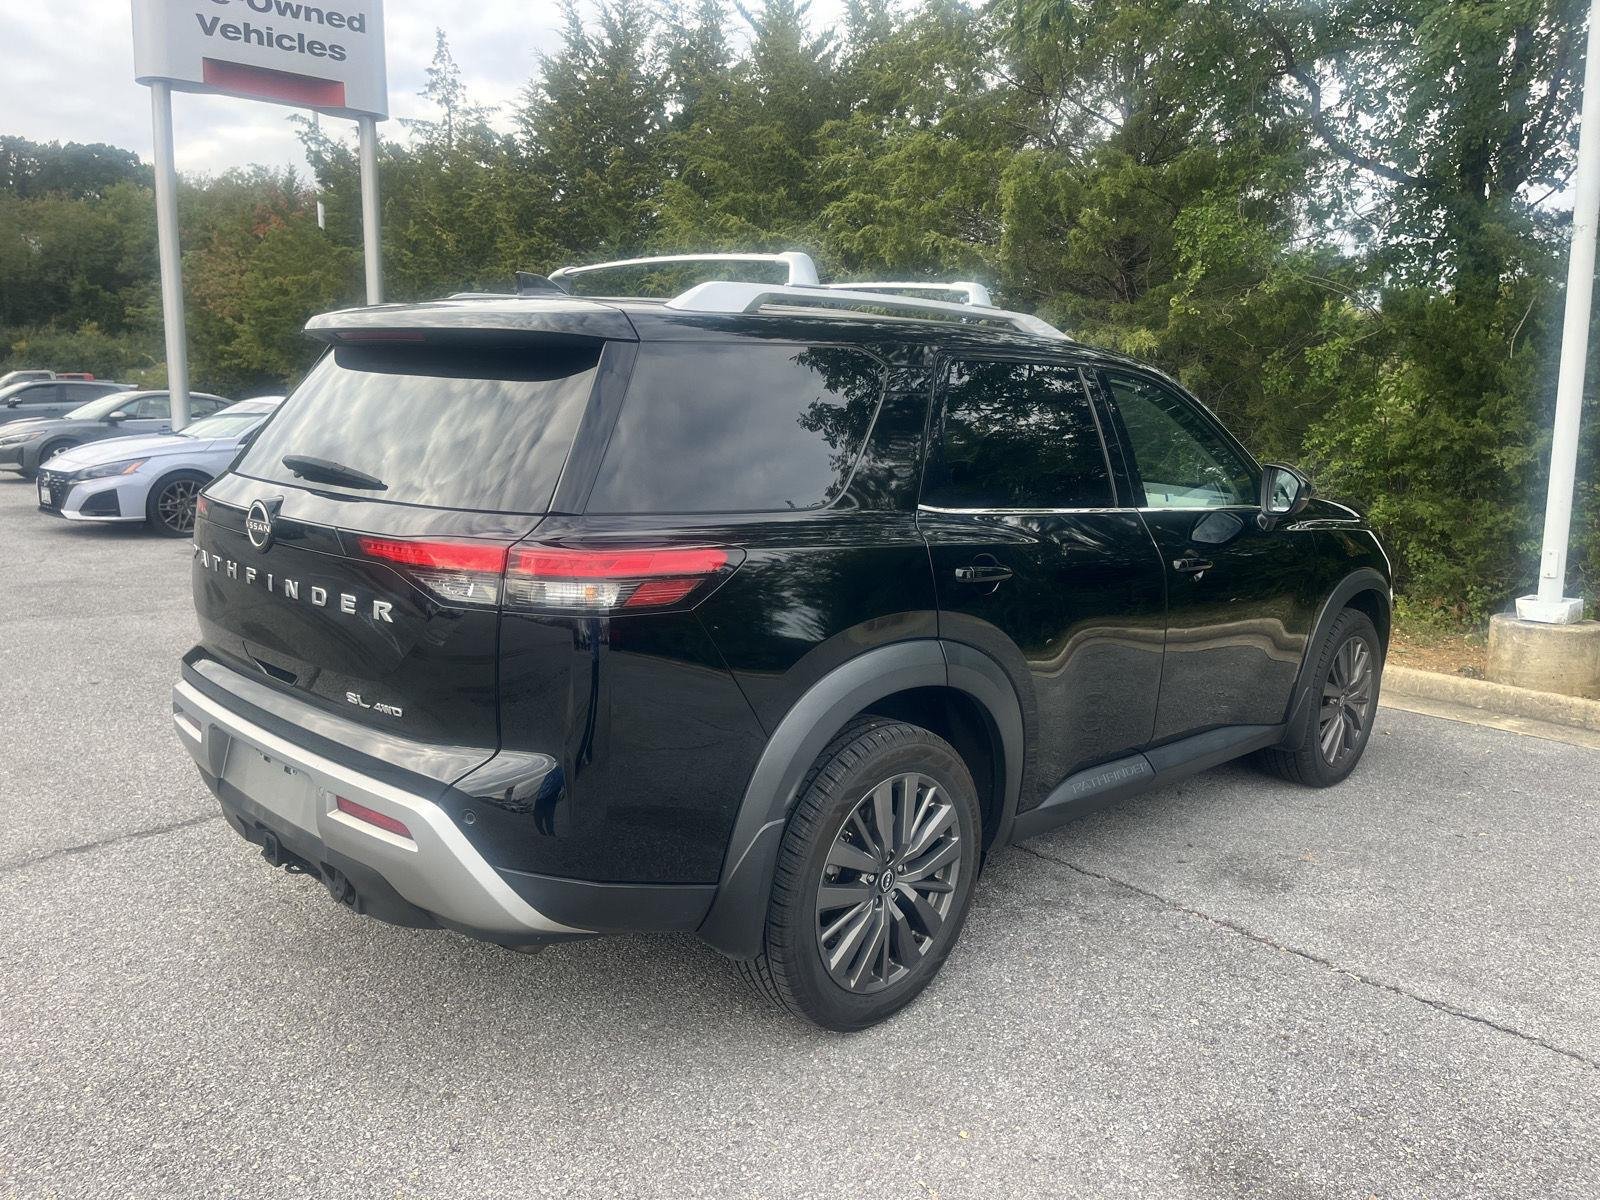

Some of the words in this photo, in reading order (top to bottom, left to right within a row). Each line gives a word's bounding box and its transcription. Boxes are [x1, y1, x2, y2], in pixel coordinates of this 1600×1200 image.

[211, 0, 366, 33] Owned
[196, 13, 347, 61] Vehicles
[246, 519, 271, 533] SSAN
[345, 691, 371, 709] SL
